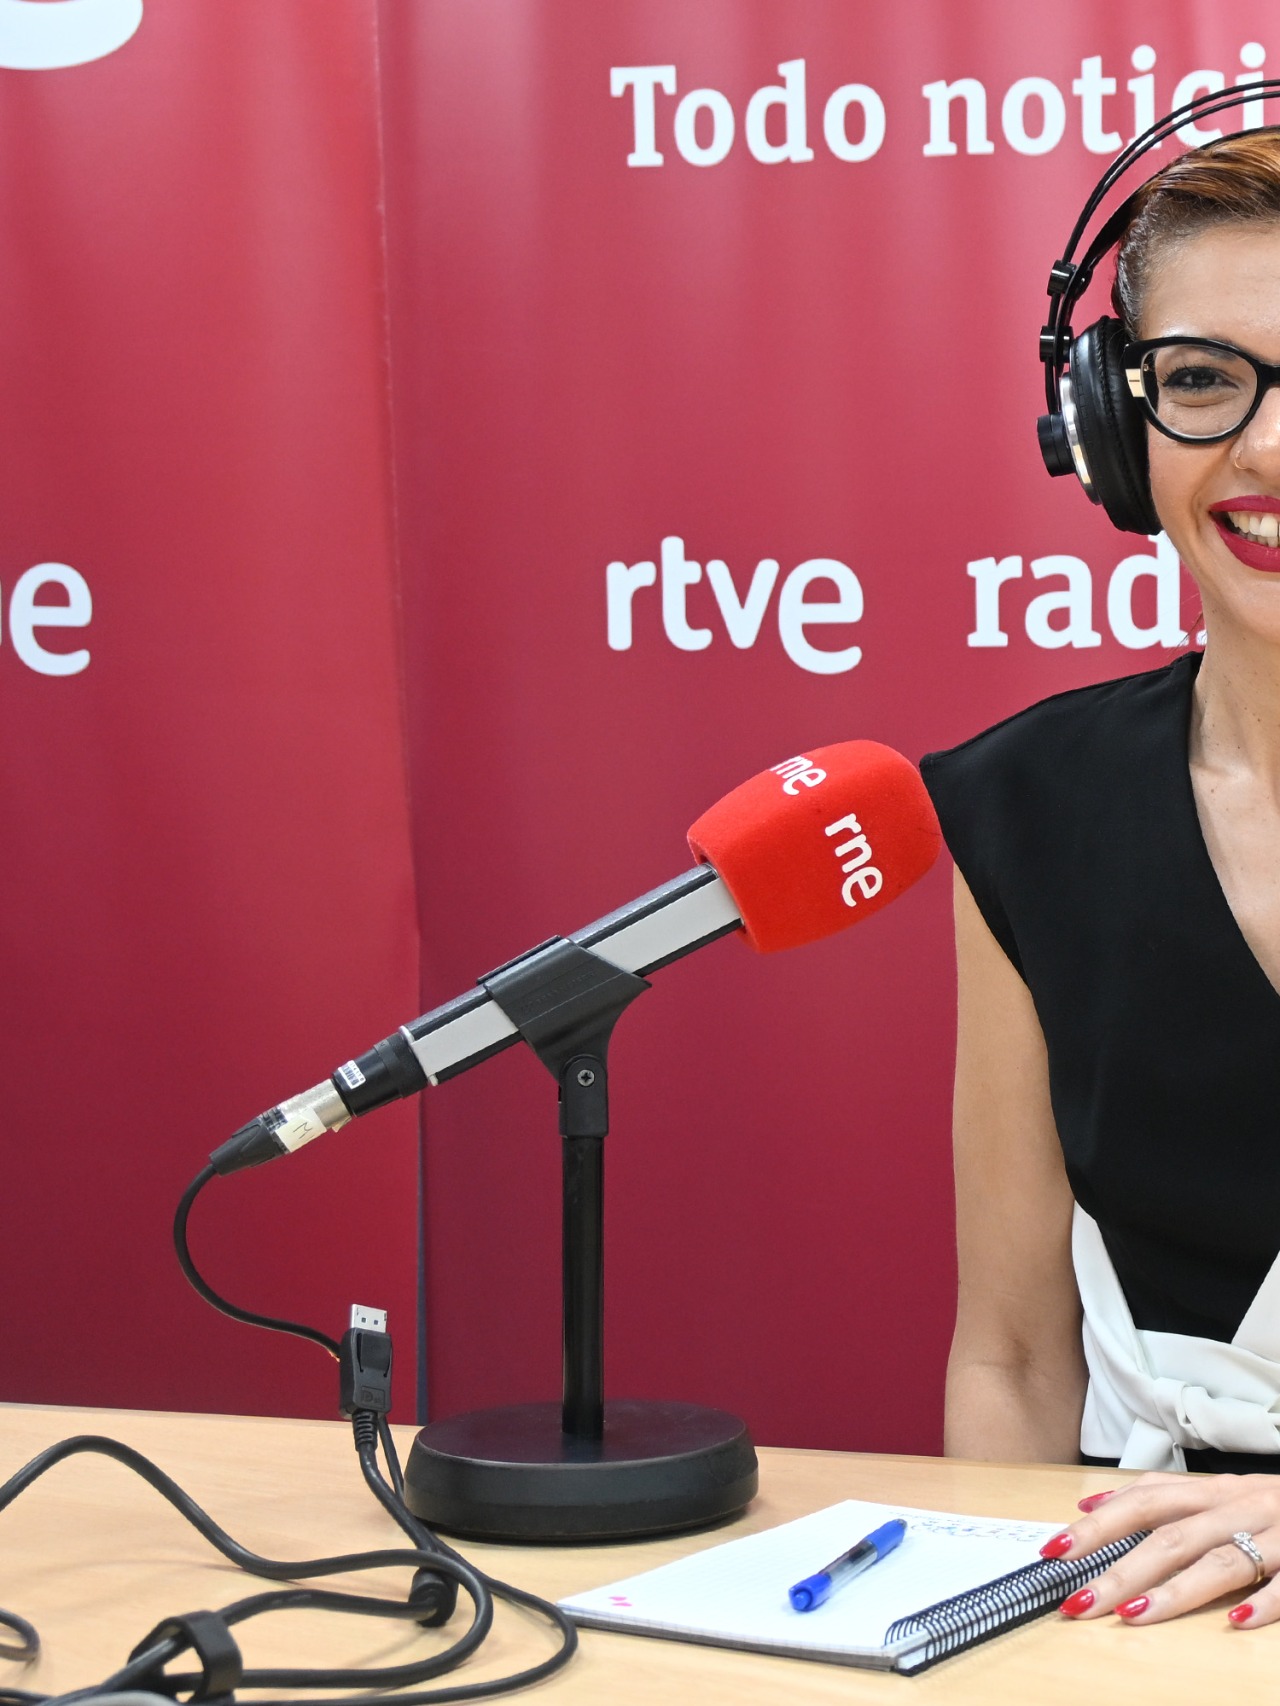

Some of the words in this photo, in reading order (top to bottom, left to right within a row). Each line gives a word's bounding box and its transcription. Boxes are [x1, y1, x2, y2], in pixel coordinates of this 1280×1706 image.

[610, 58, 886, 168] Todo
[605, 535, 865, 675] rtve
[967, 532, 1207, 649] rad
[824, 812, 884, 908] rne
